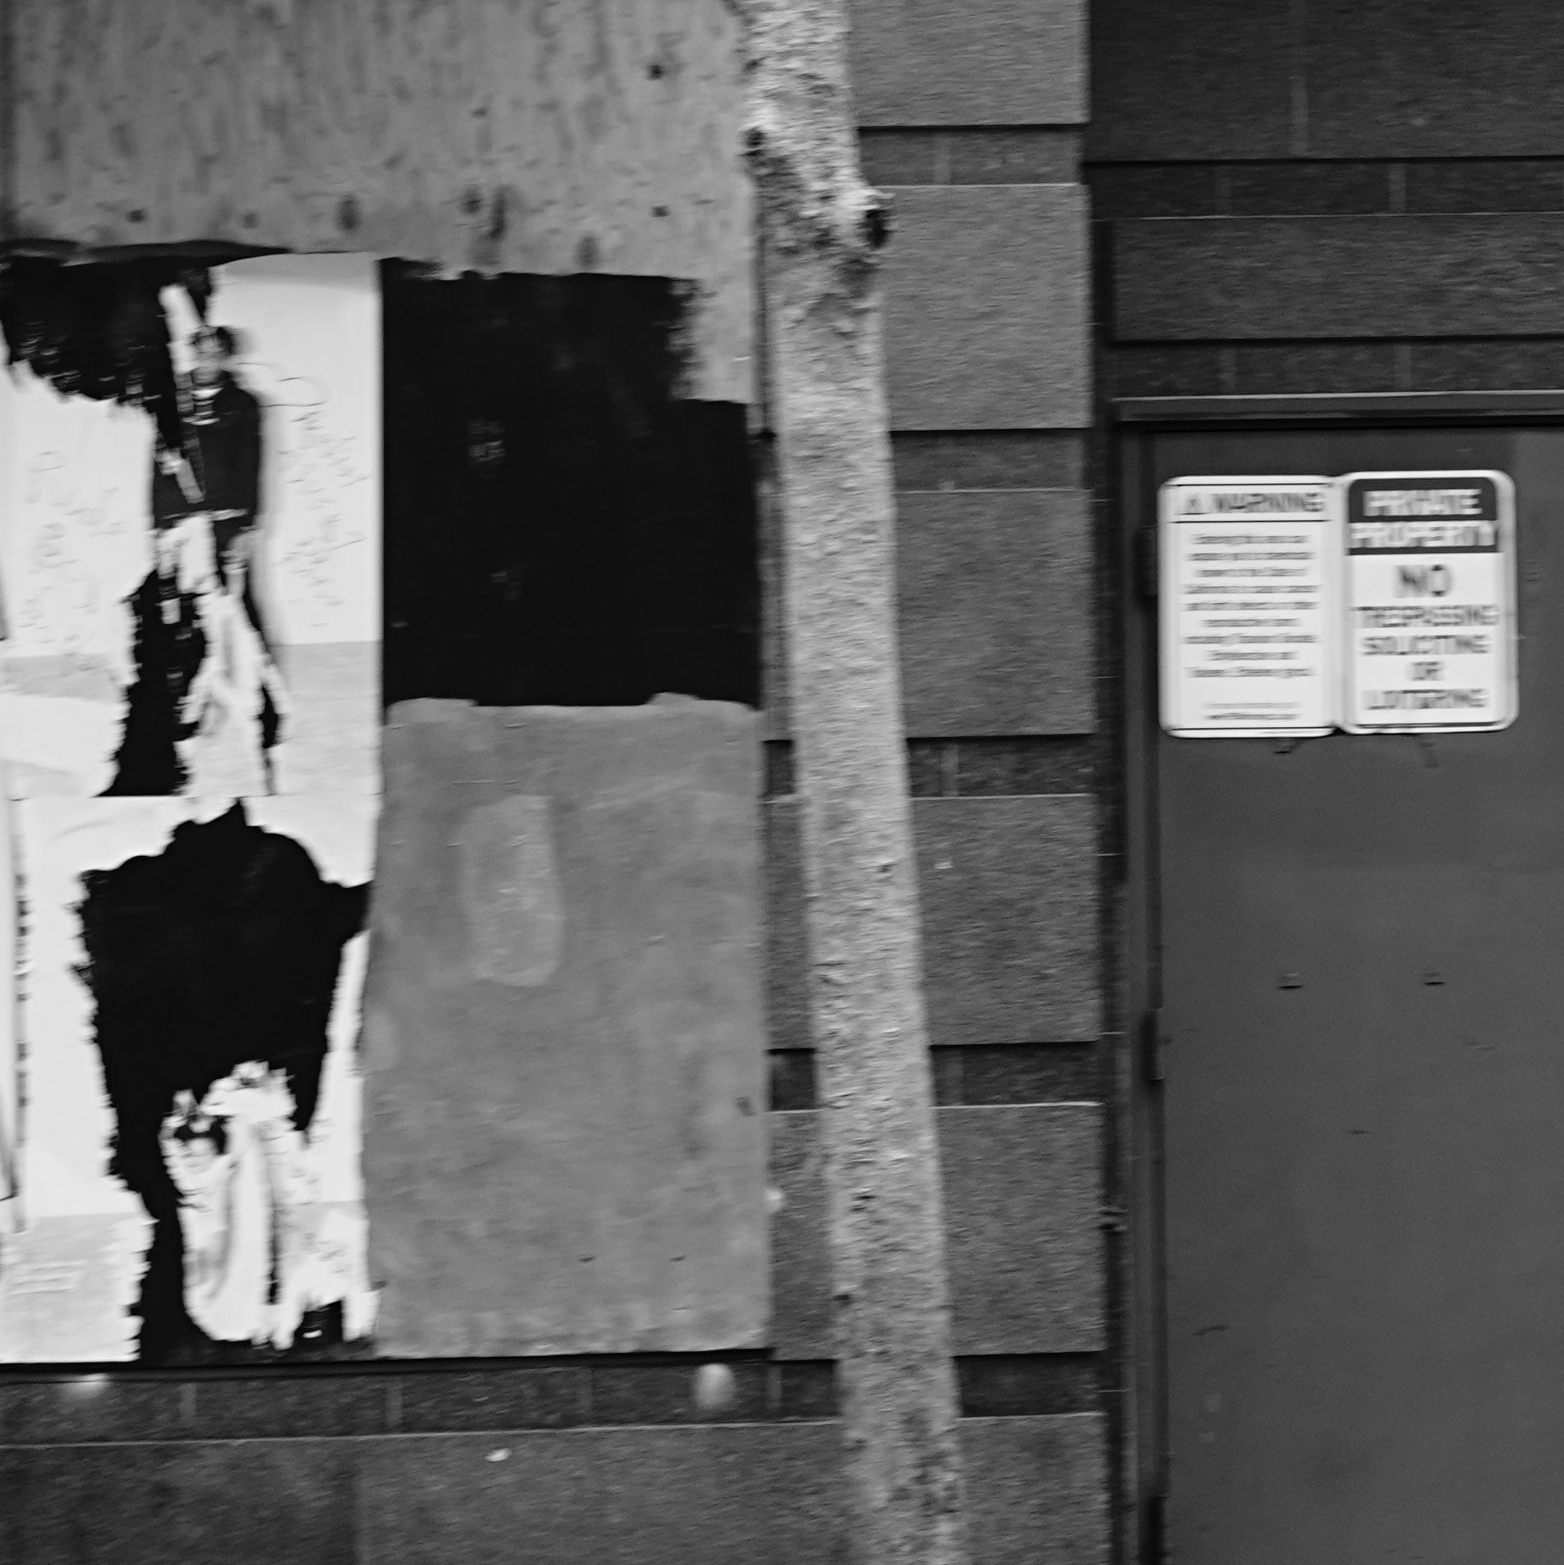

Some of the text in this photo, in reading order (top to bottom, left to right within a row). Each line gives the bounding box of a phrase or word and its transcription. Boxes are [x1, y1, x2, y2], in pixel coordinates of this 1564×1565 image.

[1210, 493, 1326, 513] WARNING
[1363, 489, 1482, 516] PRIVATE
[1349, 521, 1497, 548] PROPERTY
[1393, 564, 1453, 598] NO
[1355, 605, 1499, 628] TRESPASSING
[1360, 635, 1490, 655] SOLICITING
[1408, 661, 1444, 681] OR
[1362, 689, 1491, 711] LOITERING
